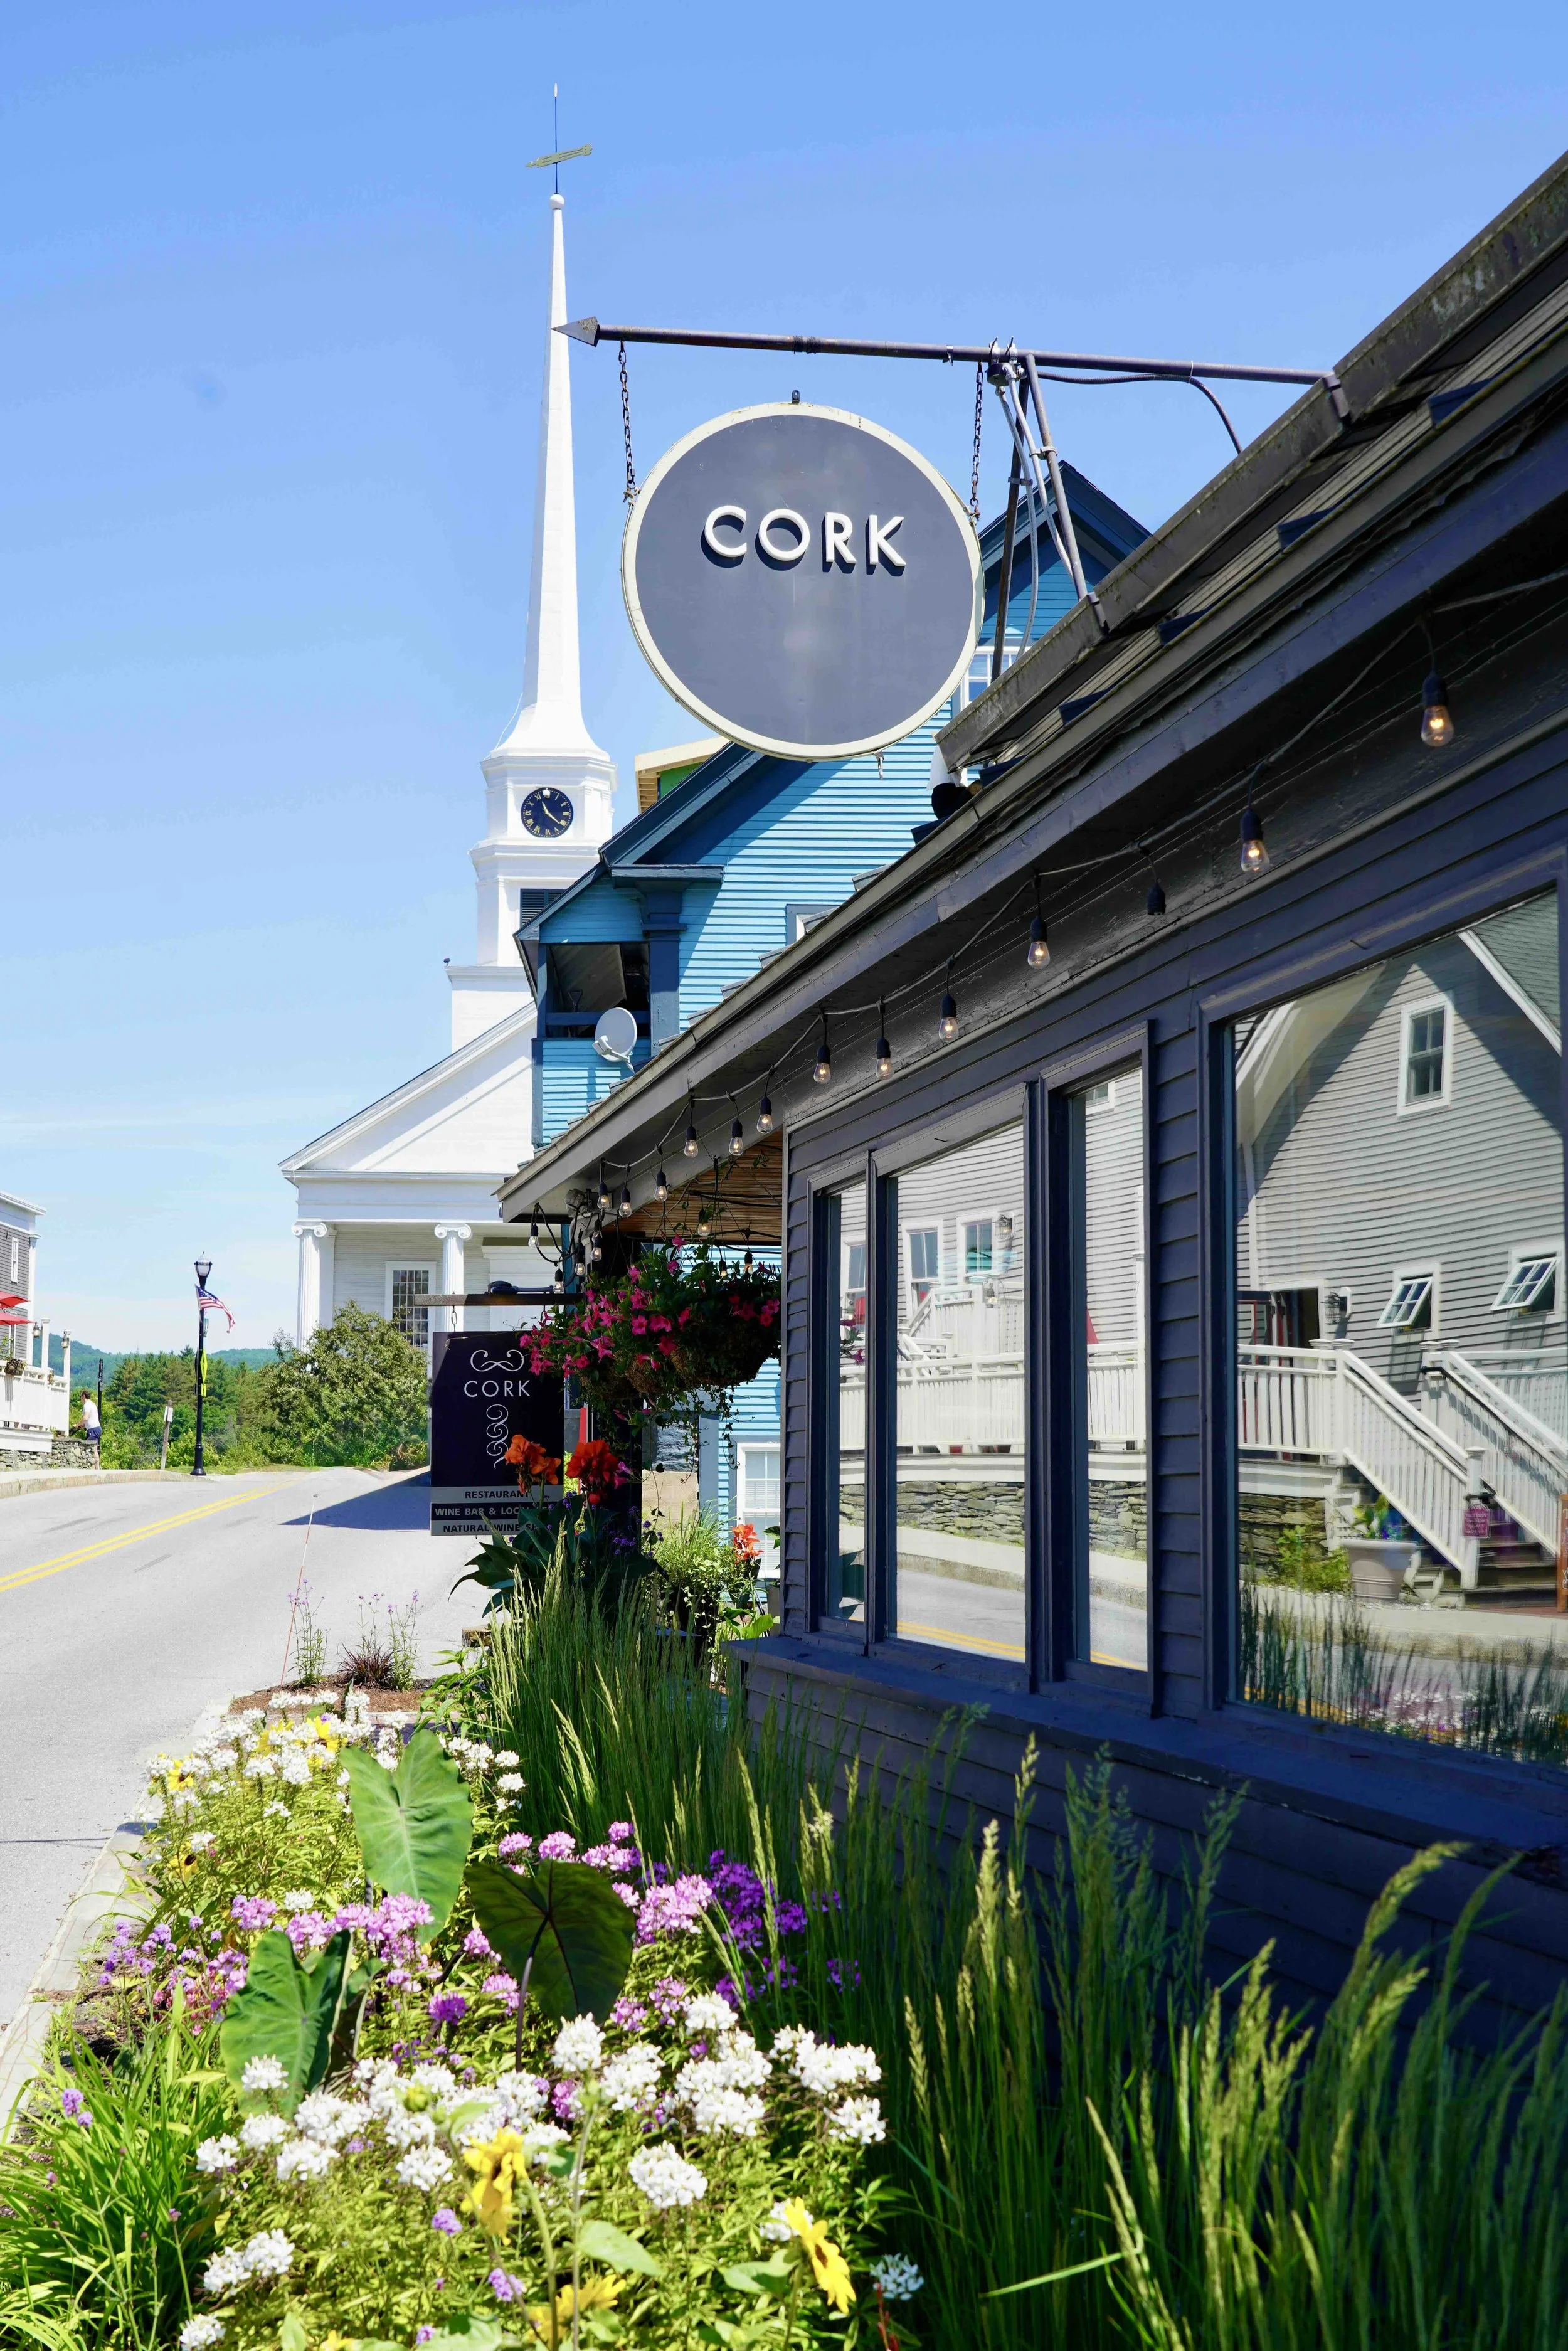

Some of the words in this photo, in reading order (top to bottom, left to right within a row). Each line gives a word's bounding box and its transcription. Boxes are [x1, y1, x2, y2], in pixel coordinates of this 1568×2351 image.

[702, 504, 908, 568] CORK
[464, 1380, 531, 1398] CORK
[435, 1507, 461, 1516] WINE
[465, 1507, 484, 1515] BAR
[489, 1507, 496, 1515] &
[443, 1524, 490, 1532] NATURAL
